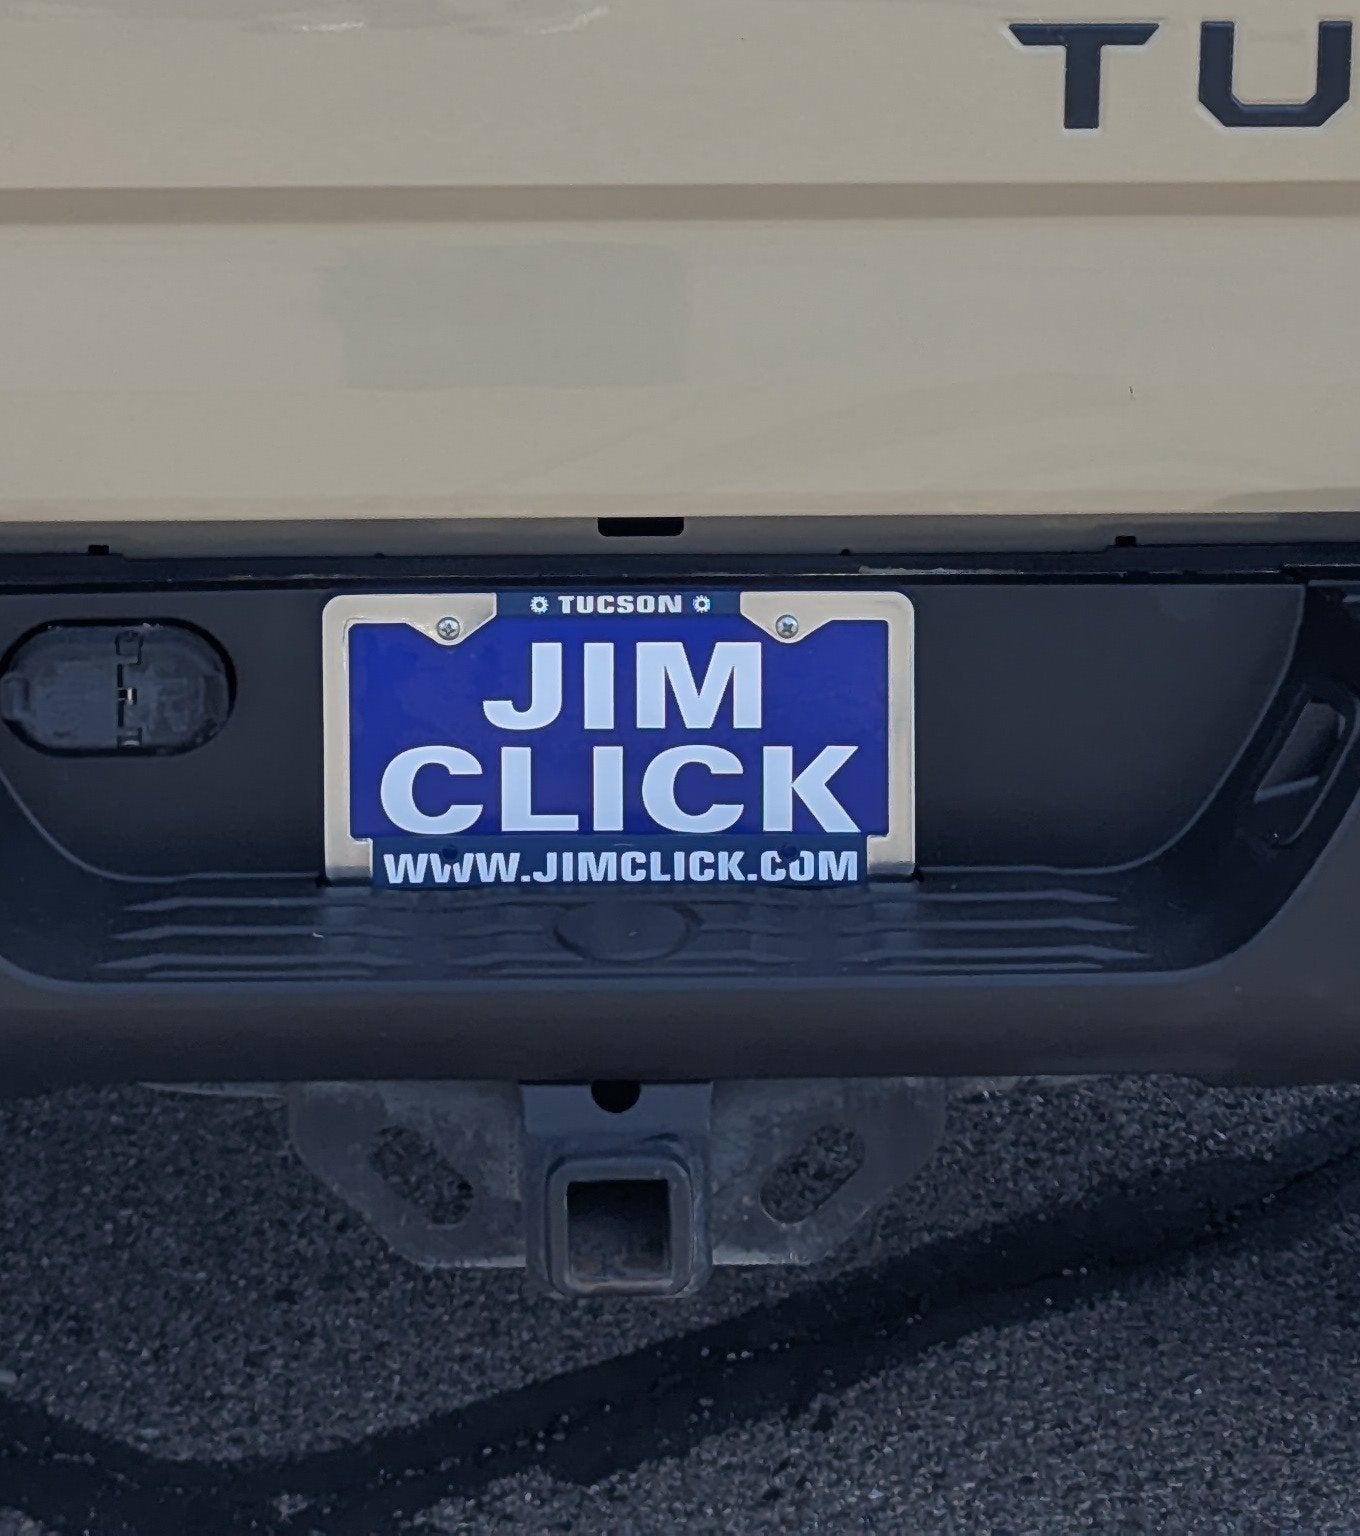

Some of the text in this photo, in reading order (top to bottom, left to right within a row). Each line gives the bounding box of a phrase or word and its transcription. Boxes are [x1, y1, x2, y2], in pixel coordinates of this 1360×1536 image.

[557, 594, 683, 615] TUCSON
[482, 641, 762, 731] JIM
[380, 744, 862, 833] CLICK
[383, 850, 858, 885] WWW.JIMCLICK.COM
